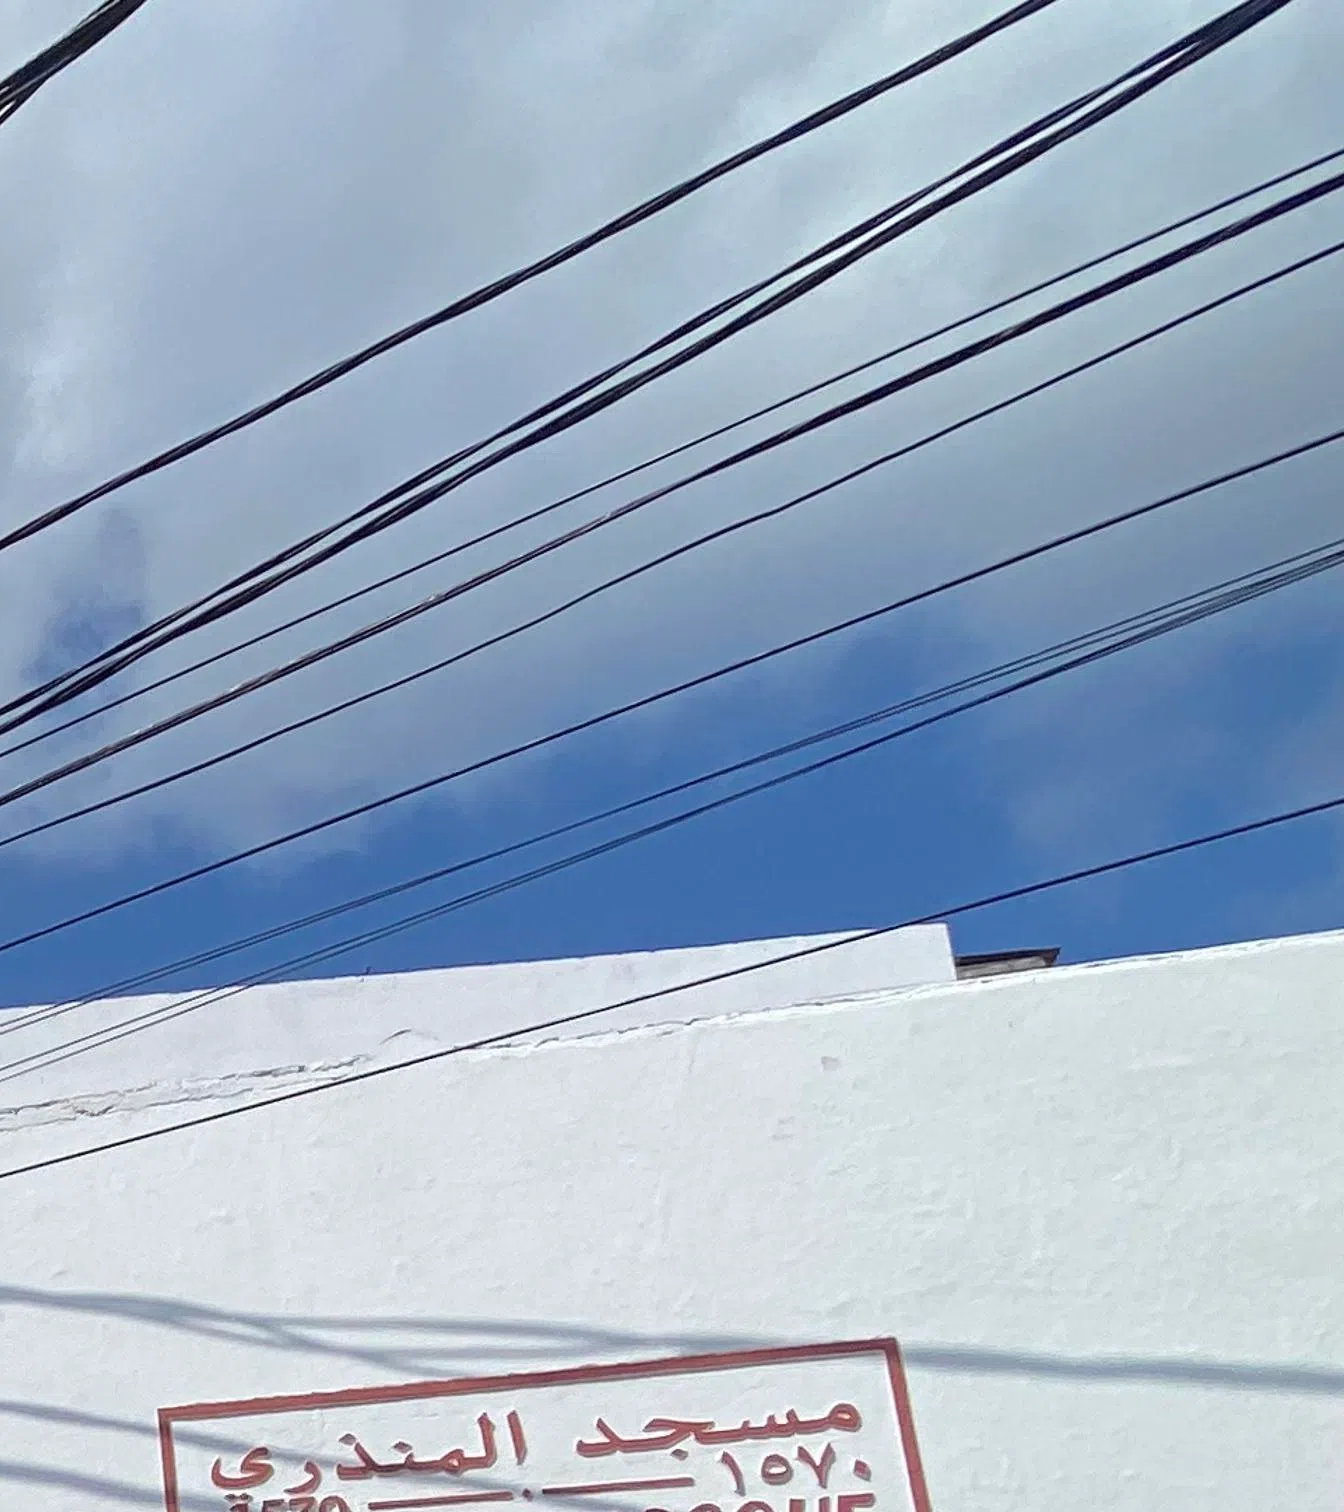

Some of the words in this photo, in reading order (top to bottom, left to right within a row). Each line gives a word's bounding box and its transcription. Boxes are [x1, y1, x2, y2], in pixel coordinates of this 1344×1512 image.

[211, 1410, 527, 1502] المنذري
[576, 1403, 862, 1461] مسجد
[720, 1442, 872, 1496] ١٥٧٠
